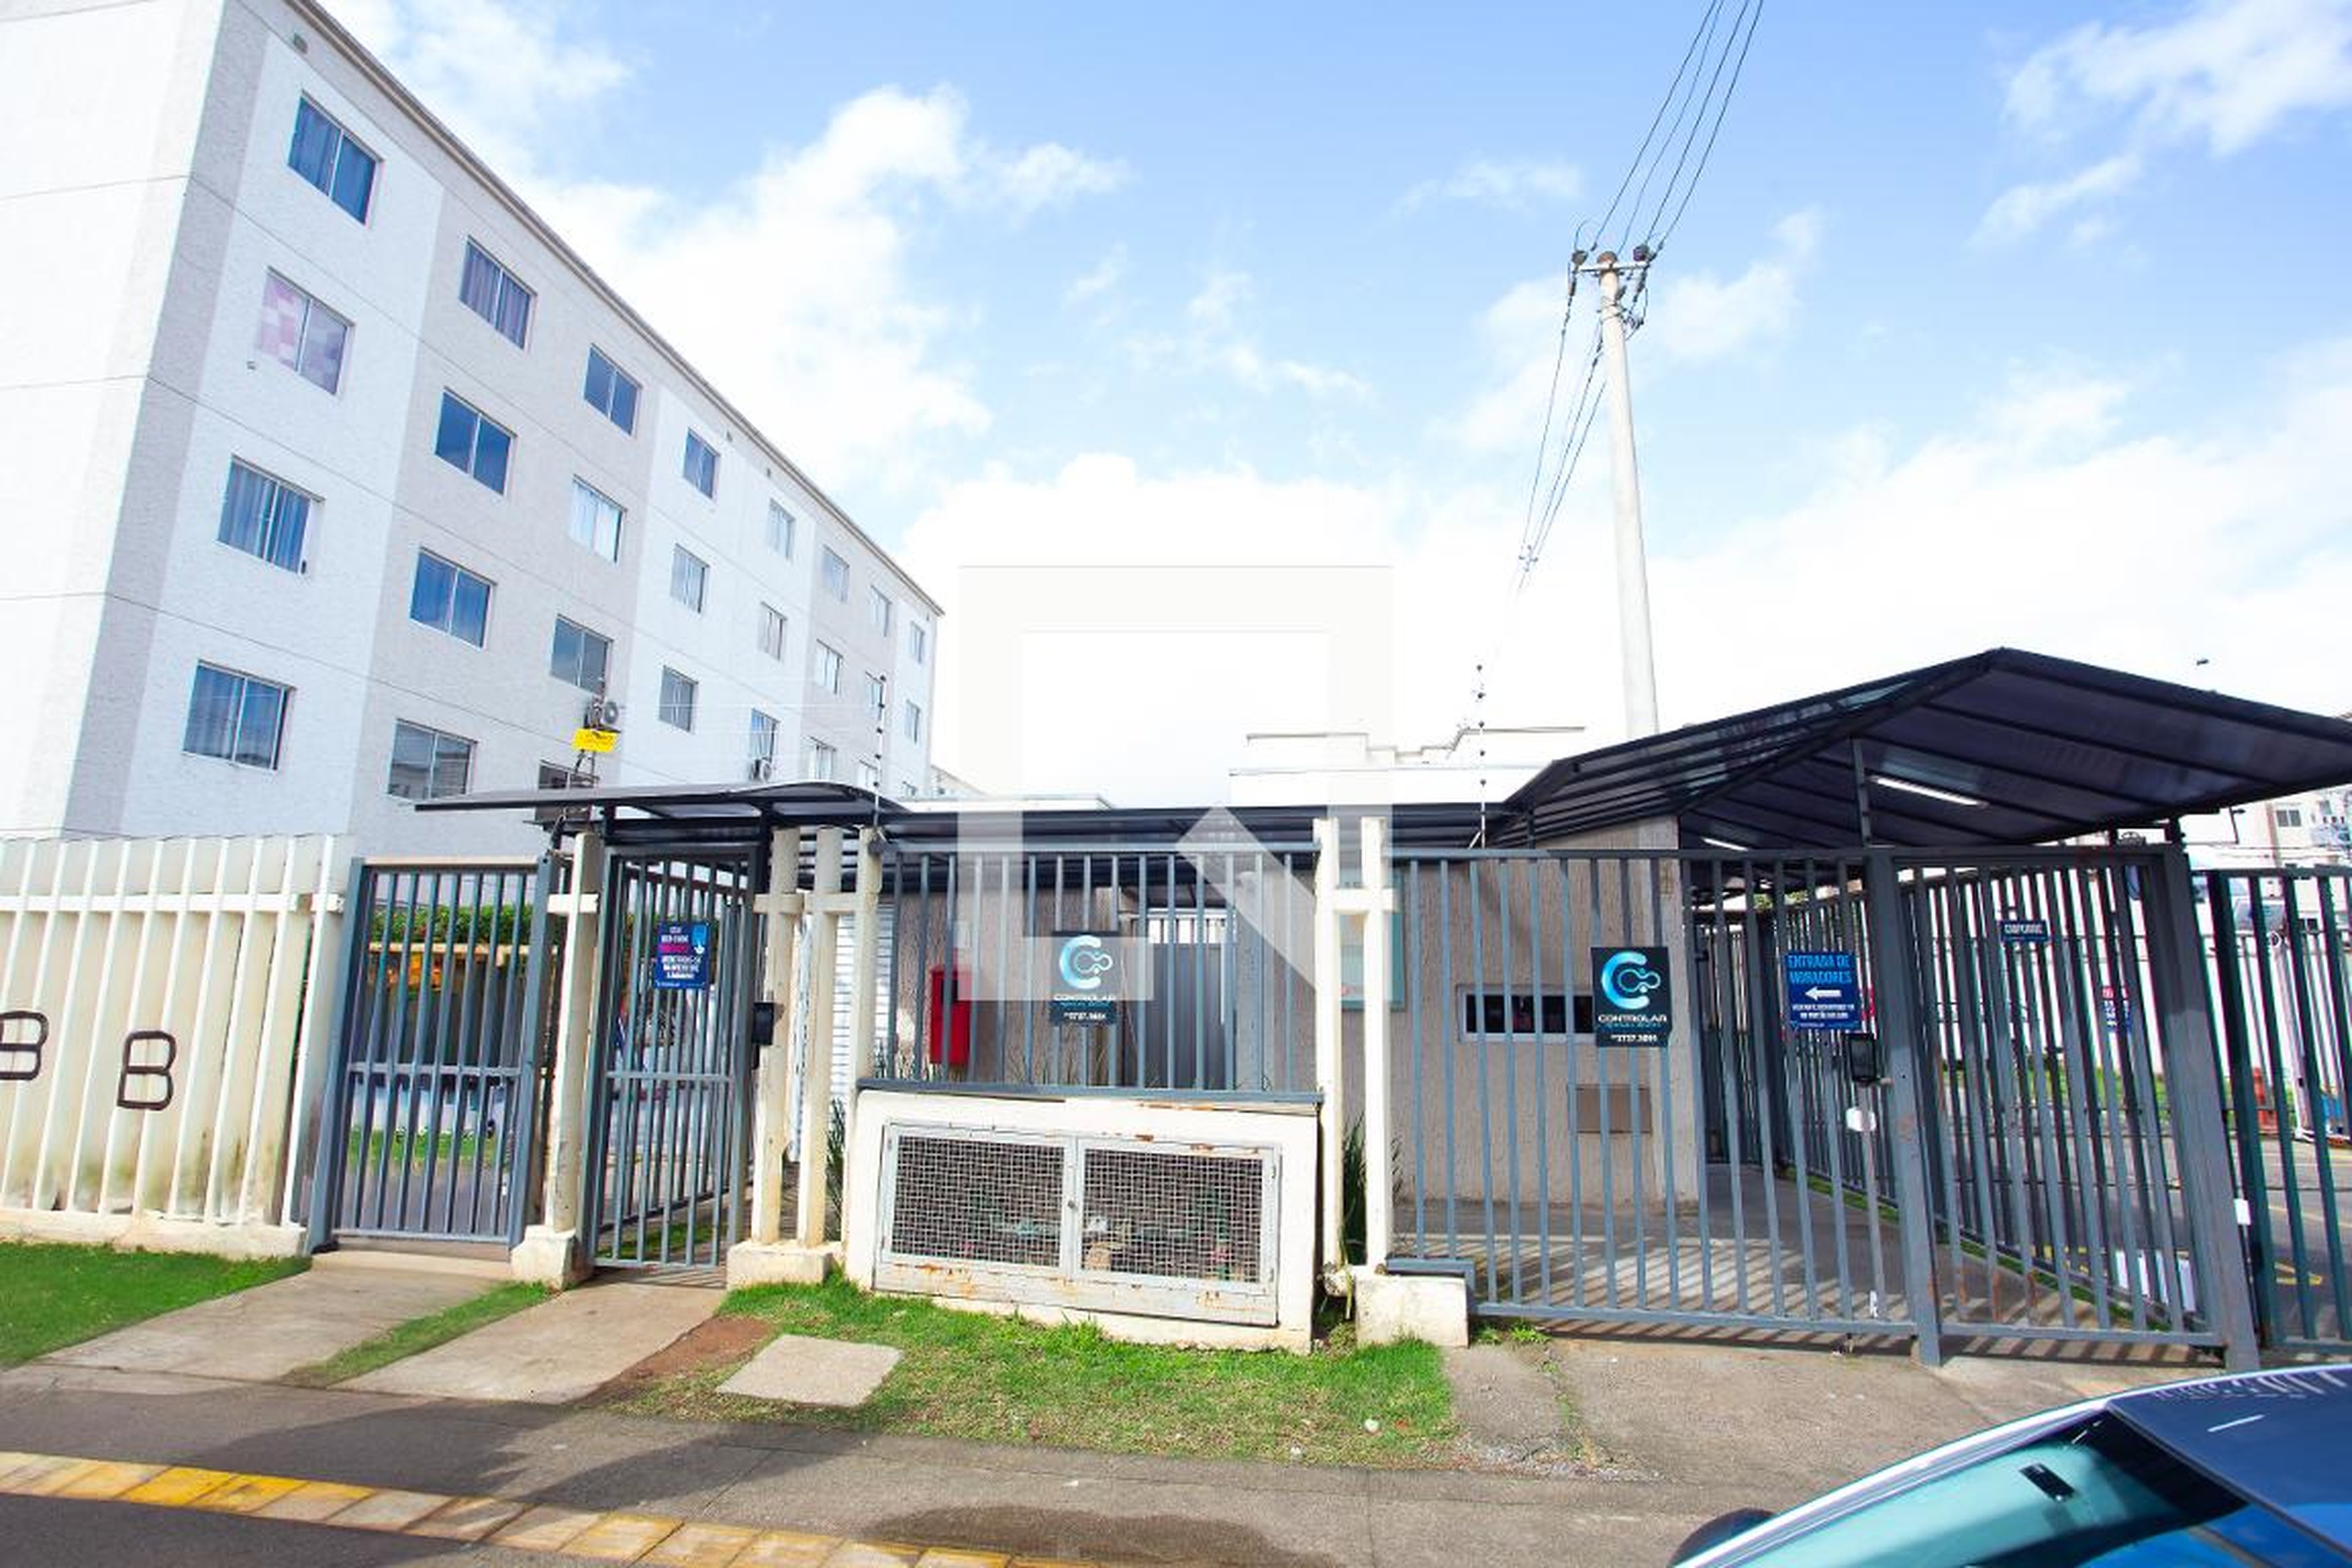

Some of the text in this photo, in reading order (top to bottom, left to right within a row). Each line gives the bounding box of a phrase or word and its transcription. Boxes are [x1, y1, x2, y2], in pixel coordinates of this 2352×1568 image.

[1789, 955, 1850, 968] ENTRADA DE
[1790, 971, 1852, 984] MORADORES
[116, 1031, 176, 1110] B
